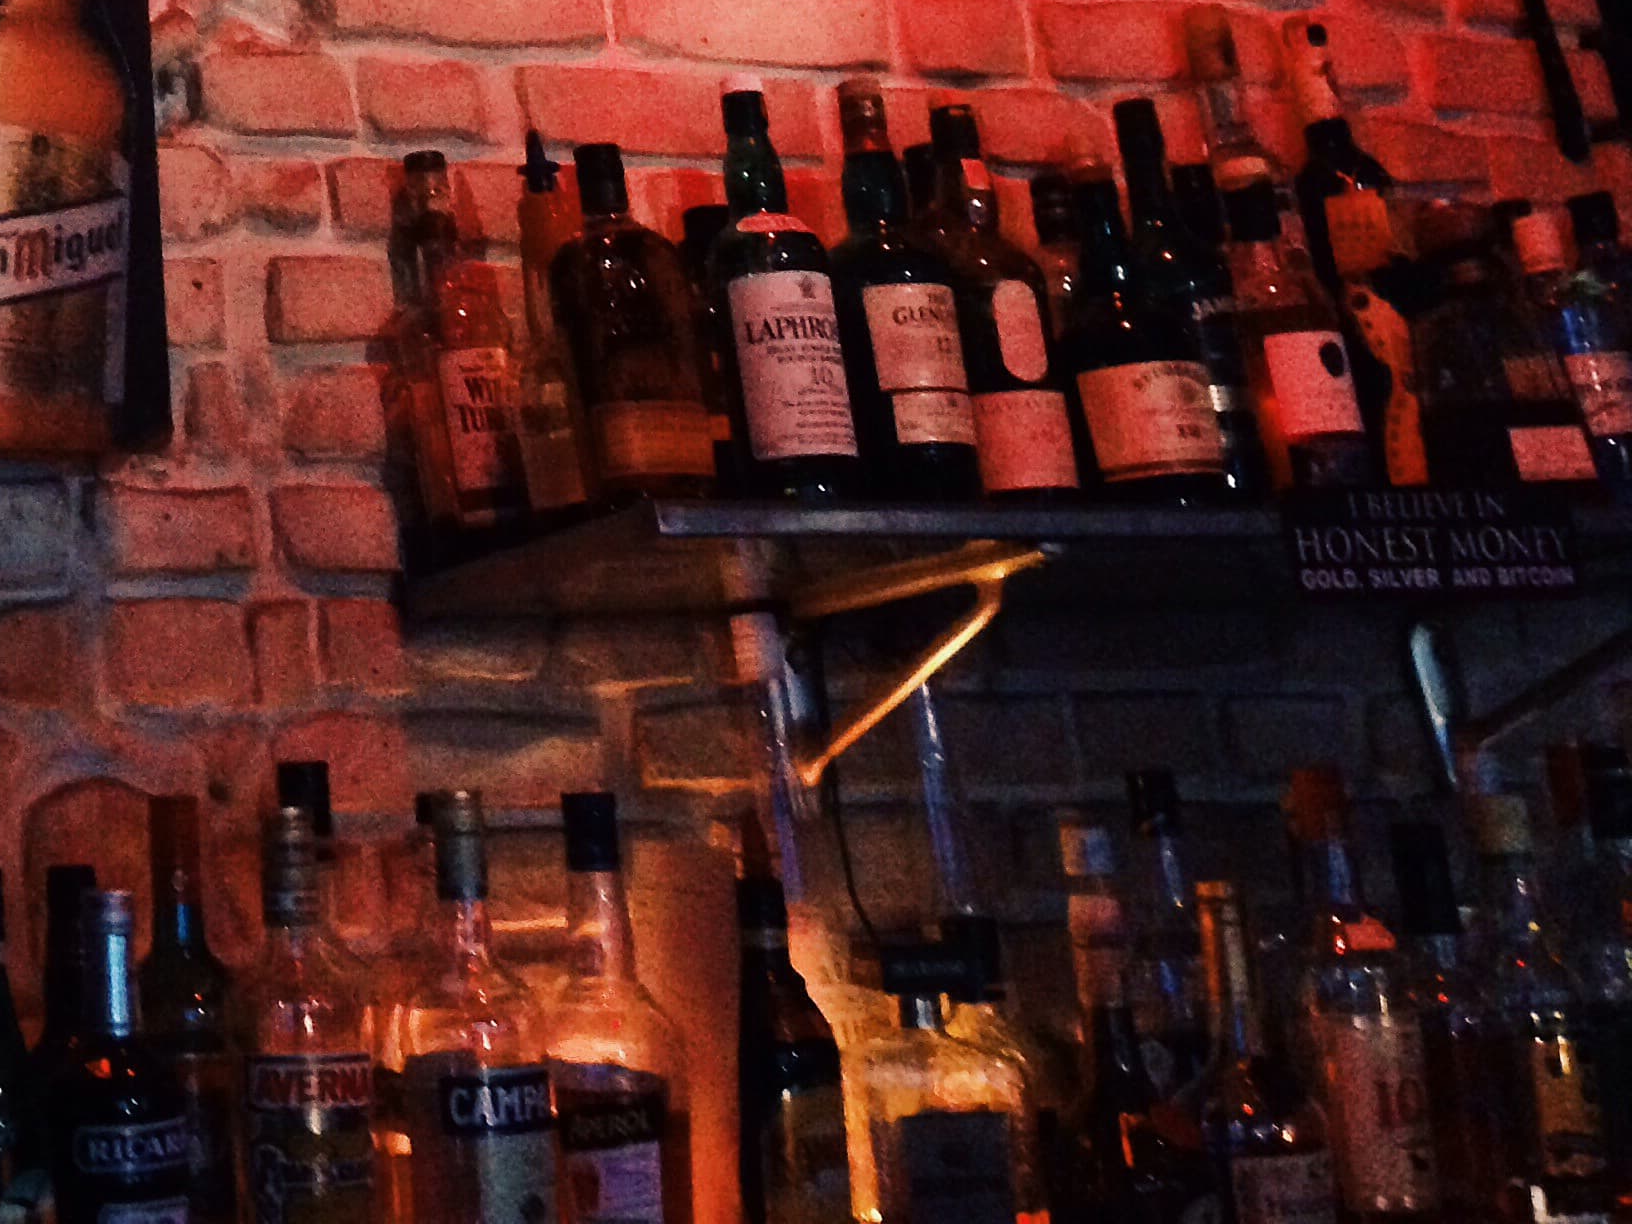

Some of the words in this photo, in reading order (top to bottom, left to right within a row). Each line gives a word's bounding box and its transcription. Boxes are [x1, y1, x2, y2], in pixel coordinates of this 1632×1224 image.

[1348, 491, 1358, 520] I
[1367, 490, 1466, 520] BELIEVE
[1473, 490, 1506, 519] IN
[1295, 525, 1438, 564] HONEST
[1449, 525, 1569, 562] MONEY
[1368, 567, 1441, 589] SILVER
[1452, 566, 1493, 588] AND
[1496, 565, 1575, 587] BITCOIN
